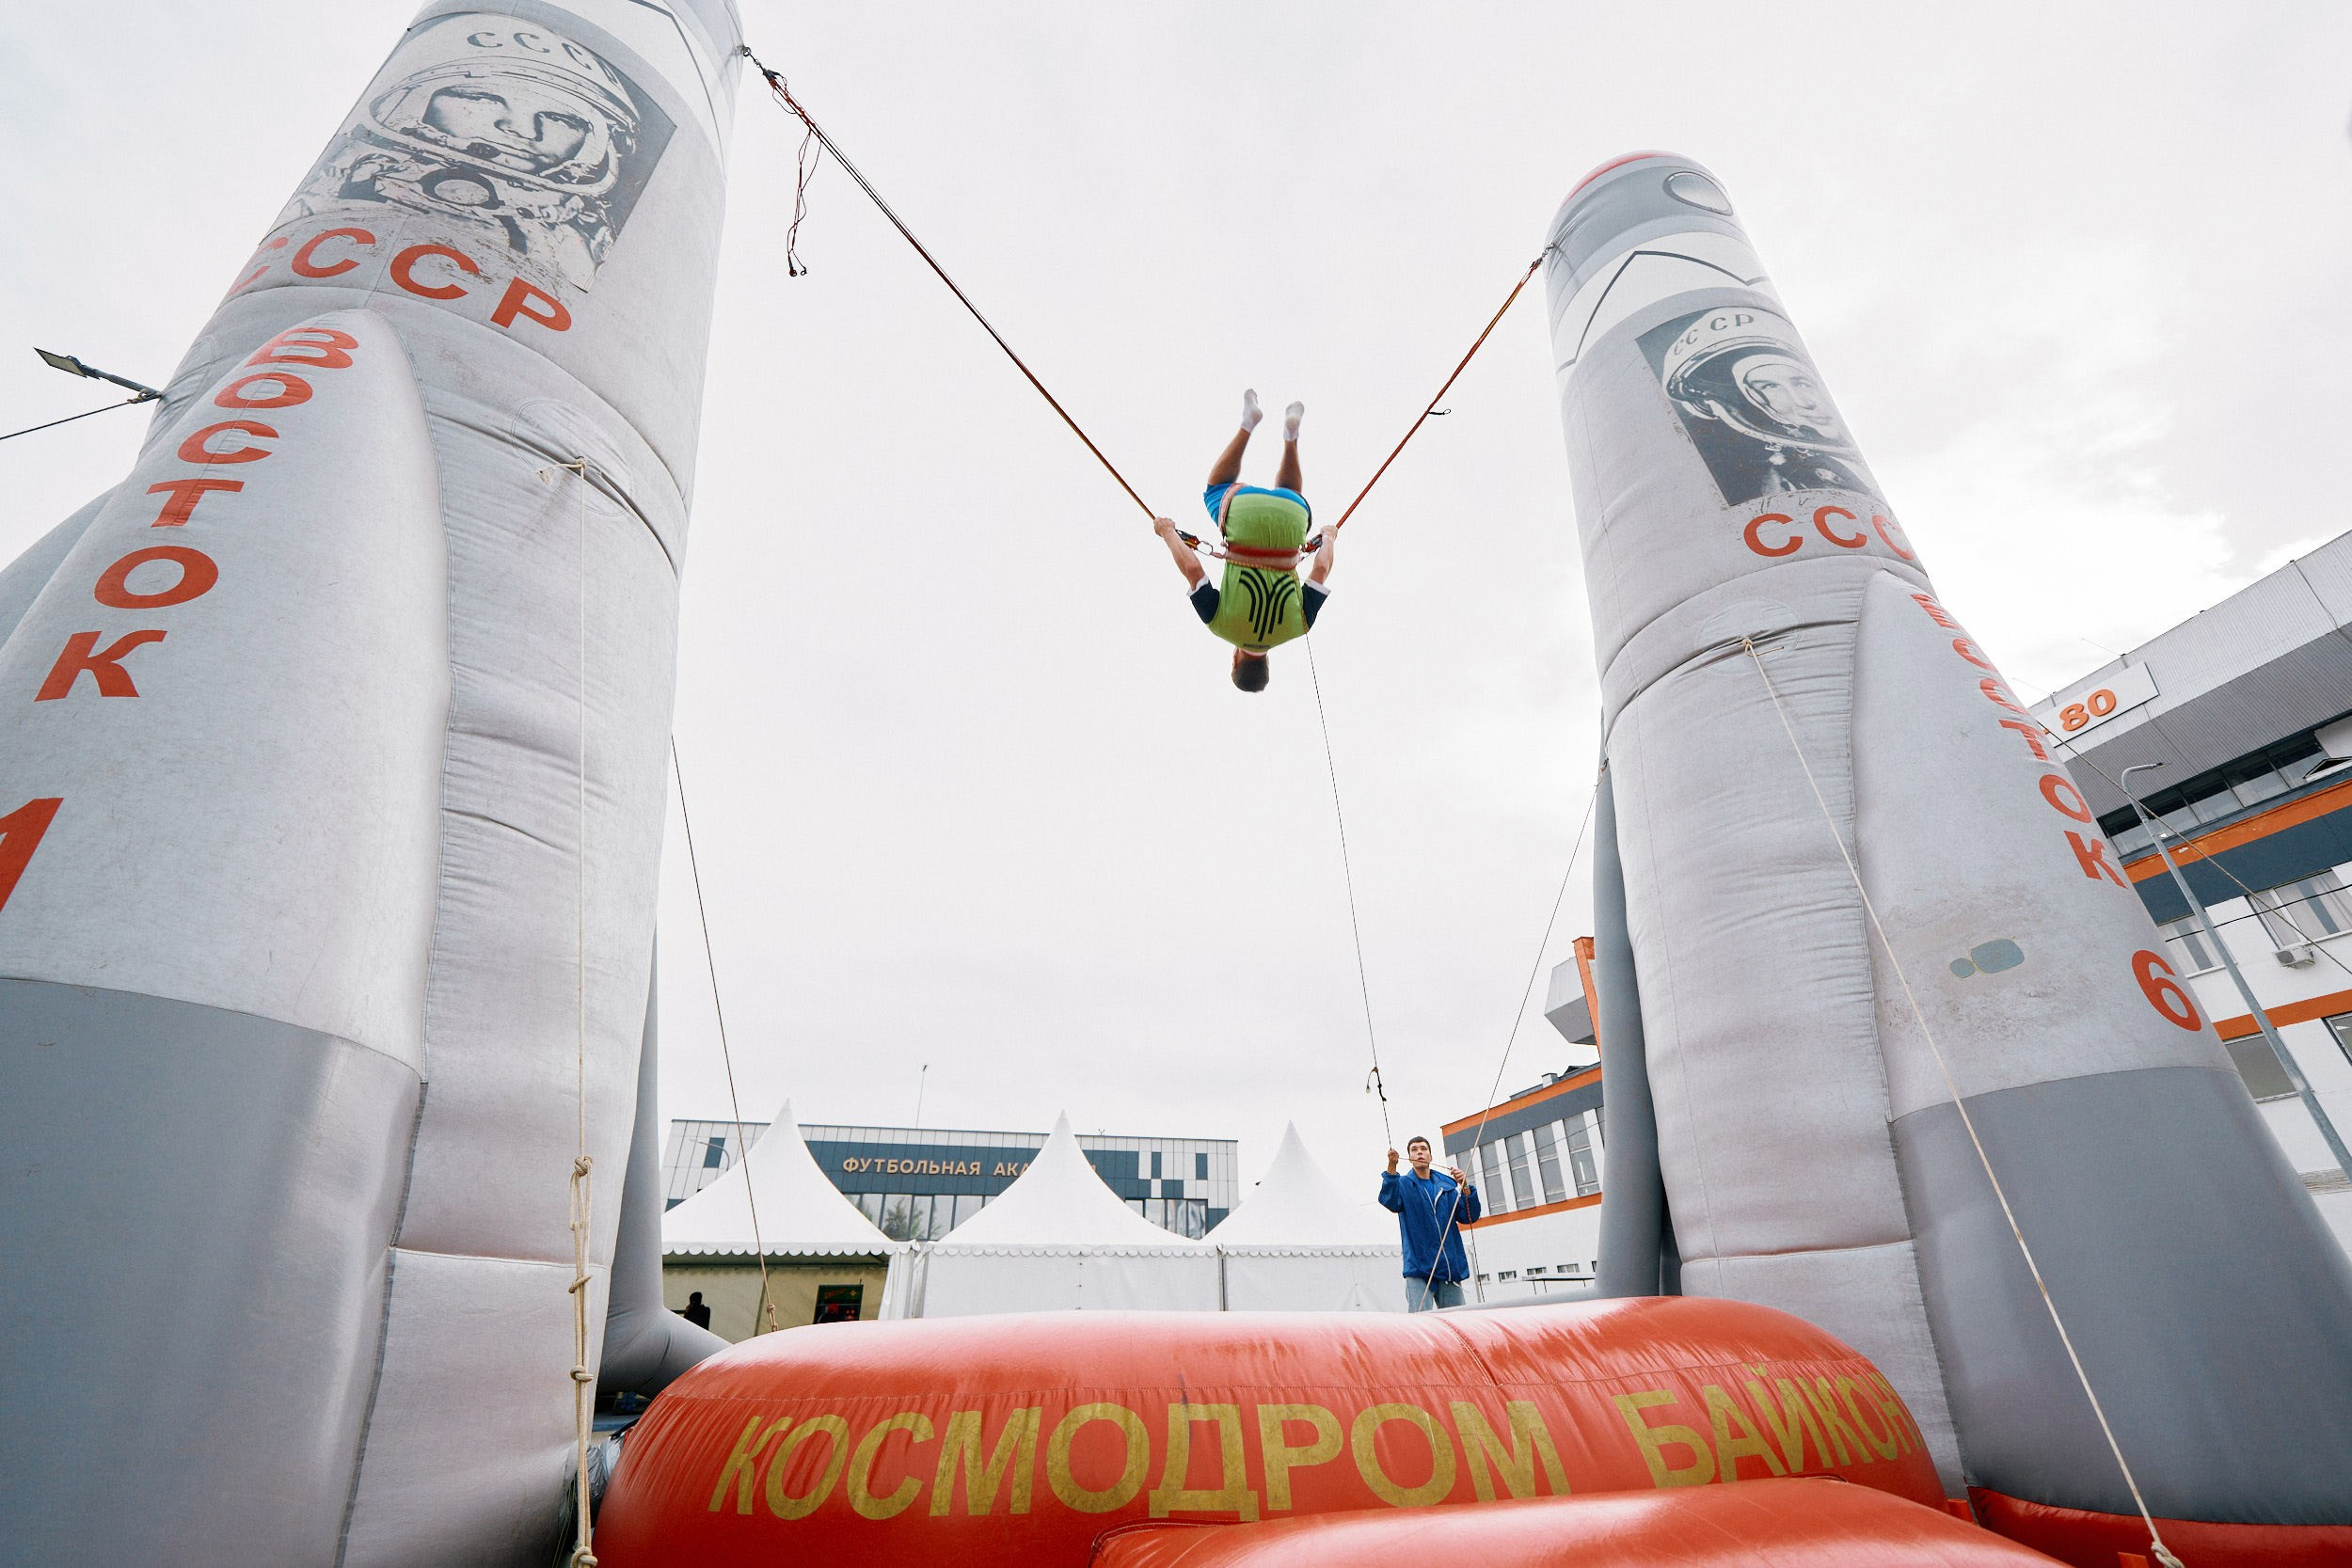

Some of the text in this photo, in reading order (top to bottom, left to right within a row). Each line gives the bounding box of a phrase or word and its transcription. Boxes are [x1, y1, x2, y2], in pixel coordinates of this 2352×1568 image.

[1674, 313, 1755, 356] СССР
[34, 327, 359, 702] ВОСТОК
[2059, 689, 2117, 732] 80
[2132, 949, 2202, 1031] 6
[842, 1157, 981, 1176] ФУТБОЛЬНАЯ
[708, 1402, 1572, 1521] КОСМОДРОМ
